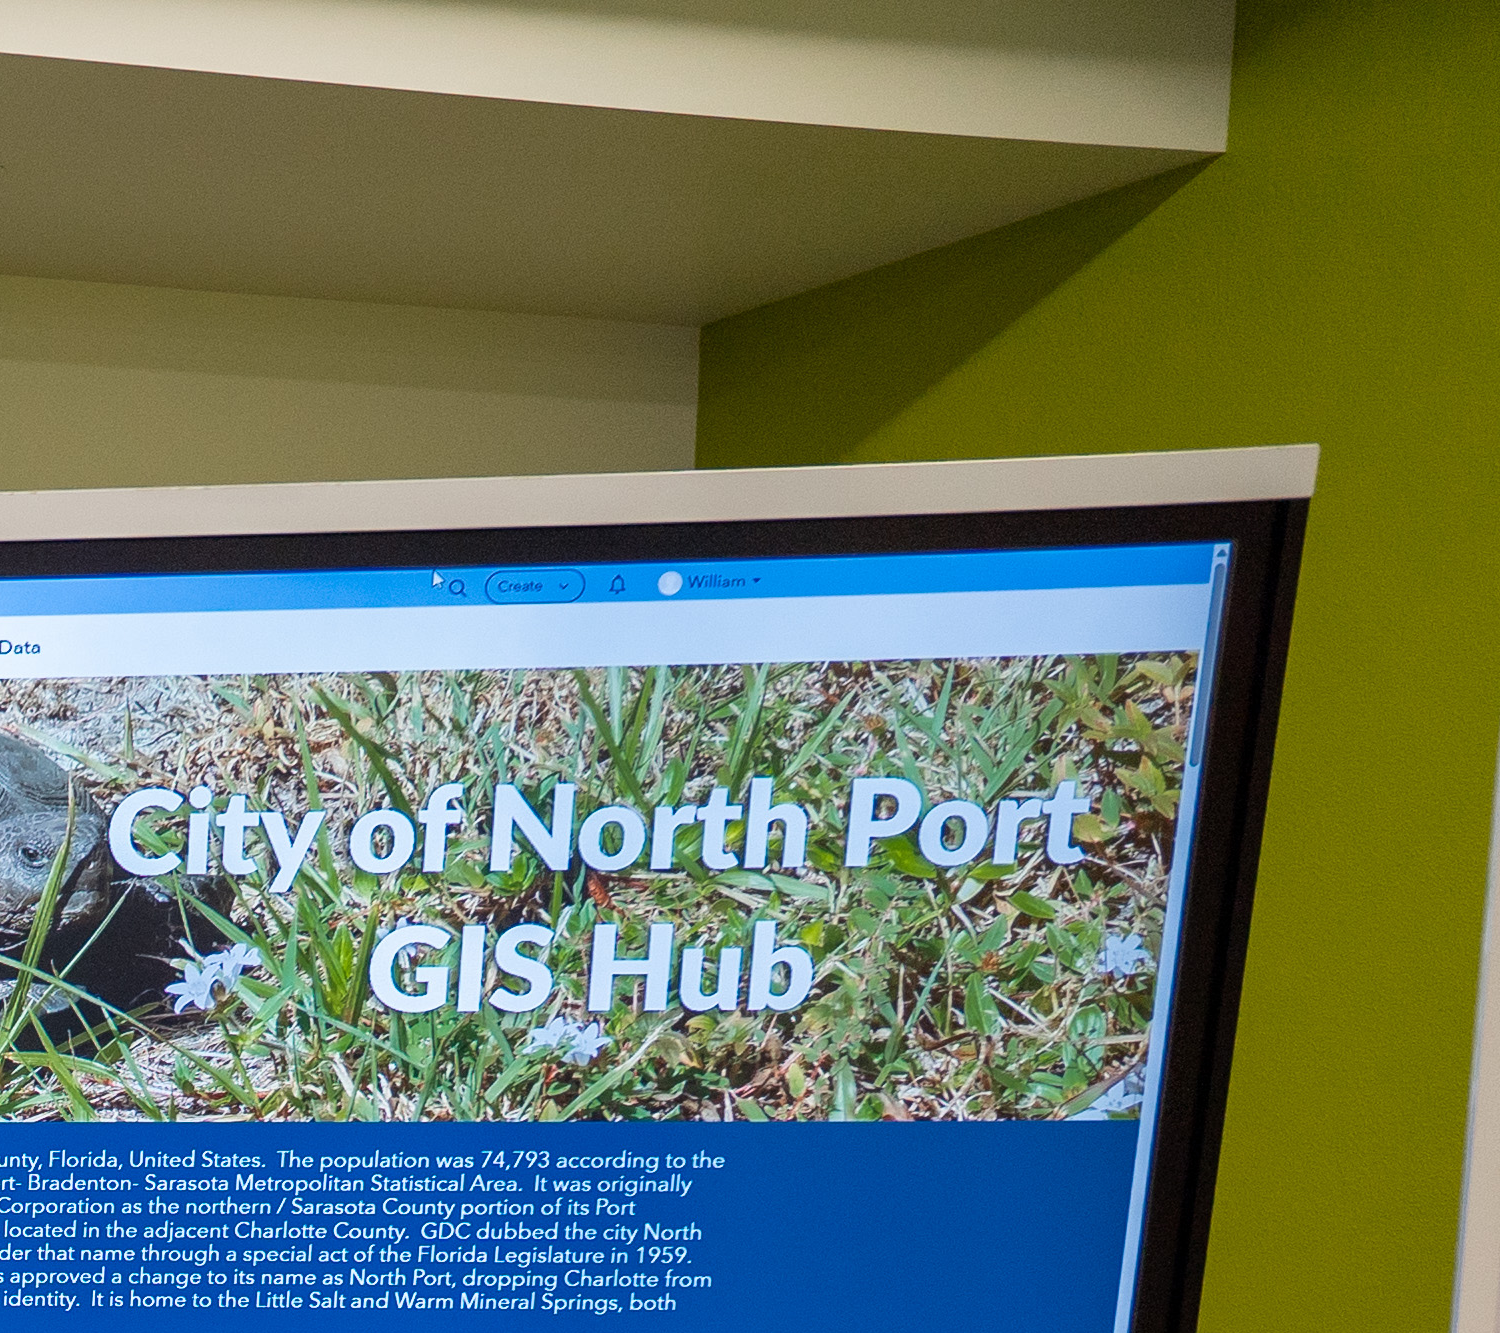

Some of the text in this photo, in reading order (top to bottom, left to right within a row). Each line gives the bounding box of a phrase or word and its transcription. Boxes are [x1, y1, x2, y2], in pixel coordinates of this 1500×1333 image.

[498, 581, 543, 593] Create
[687, 574, 746, 589] William
[107, 776, 1093, 893] City of North Port
[369, 919, 816, 1014] GIS Hub
[48, 1149, 123, 1171] Florida,
[129, 1149, 196, 1168] United
[201, 1150, 266, 1168] States.
[276, 1149, 314, 1168] The
[319, 1149, 430, 1173] population
[435, 1156, 474, 1169] was
[481, 1150, 550, 1171] 74,793
[556, 1150, 659, 1174] according
[666, 1153, 686, 1169] to
[692, 1150, 726, 1169] the
[28, 1171, 139, 1192] Bradenton-
[144, 1173, 229, 1191] Sarasota
[235, 1172, 364, 1196] Metropolitan
[370, 1173, 465, 1192] Statistical
[469, 1174, 523, 1192] Area.
[534, 1174, 548, 1192] It
[552, 1179, 592, 1192] was
[597, 1173, 692, 1198] originally
[121, 1202, 142, 1215] as
[148, 1195, 180, 1215] the
[185, 1196, 271, 1215] northern
[276, 1197, 287, 1214] /
[291, 1197, 376, 1216] Sarasota
[382, 1197, 456, 1220] County
[460, 1198, 534, 1220] portion
[540, 1196, 563, 1216] of
[567, 1198, 590, 1216] its
[595, 1198, 636, 1216] Port
[4, 1219, 77, 1239] located
[82, 1221, 100, 1239] in
[105, 1219, 138, 1239] the
[143, 1220, 229, 1243] adjacent
[234, 1220, 328, 1239] Charlotte
[333, 1221, 410, 1244] County.
[420, 1221, 471, 1240] GDC
[476, 1221, 559, 1240] dubbed
[564, 1221, 597, 1240] the
[602, 1223, 638, 1245] city
[643, 1222, 702, 1241] North
[36, 1243, 76, 1262] that
[80, 1249, 136, 1262] name
[141, 1243, 220, 1266] through
[225, 1250, 237, 1262] a
[242, 1243, 313, 1266] special
[318, 1248, 348, 1264] act
[352, 1243, 376, 1263] of
[378, 1243, 413, 1263] the
[417, 1244, 488, 1263] Florida
[493, 1245, 605, 1268] Legislature
[610, 1246, 629, 1264] in
[636, 1245, 692, 1264] 1959.
